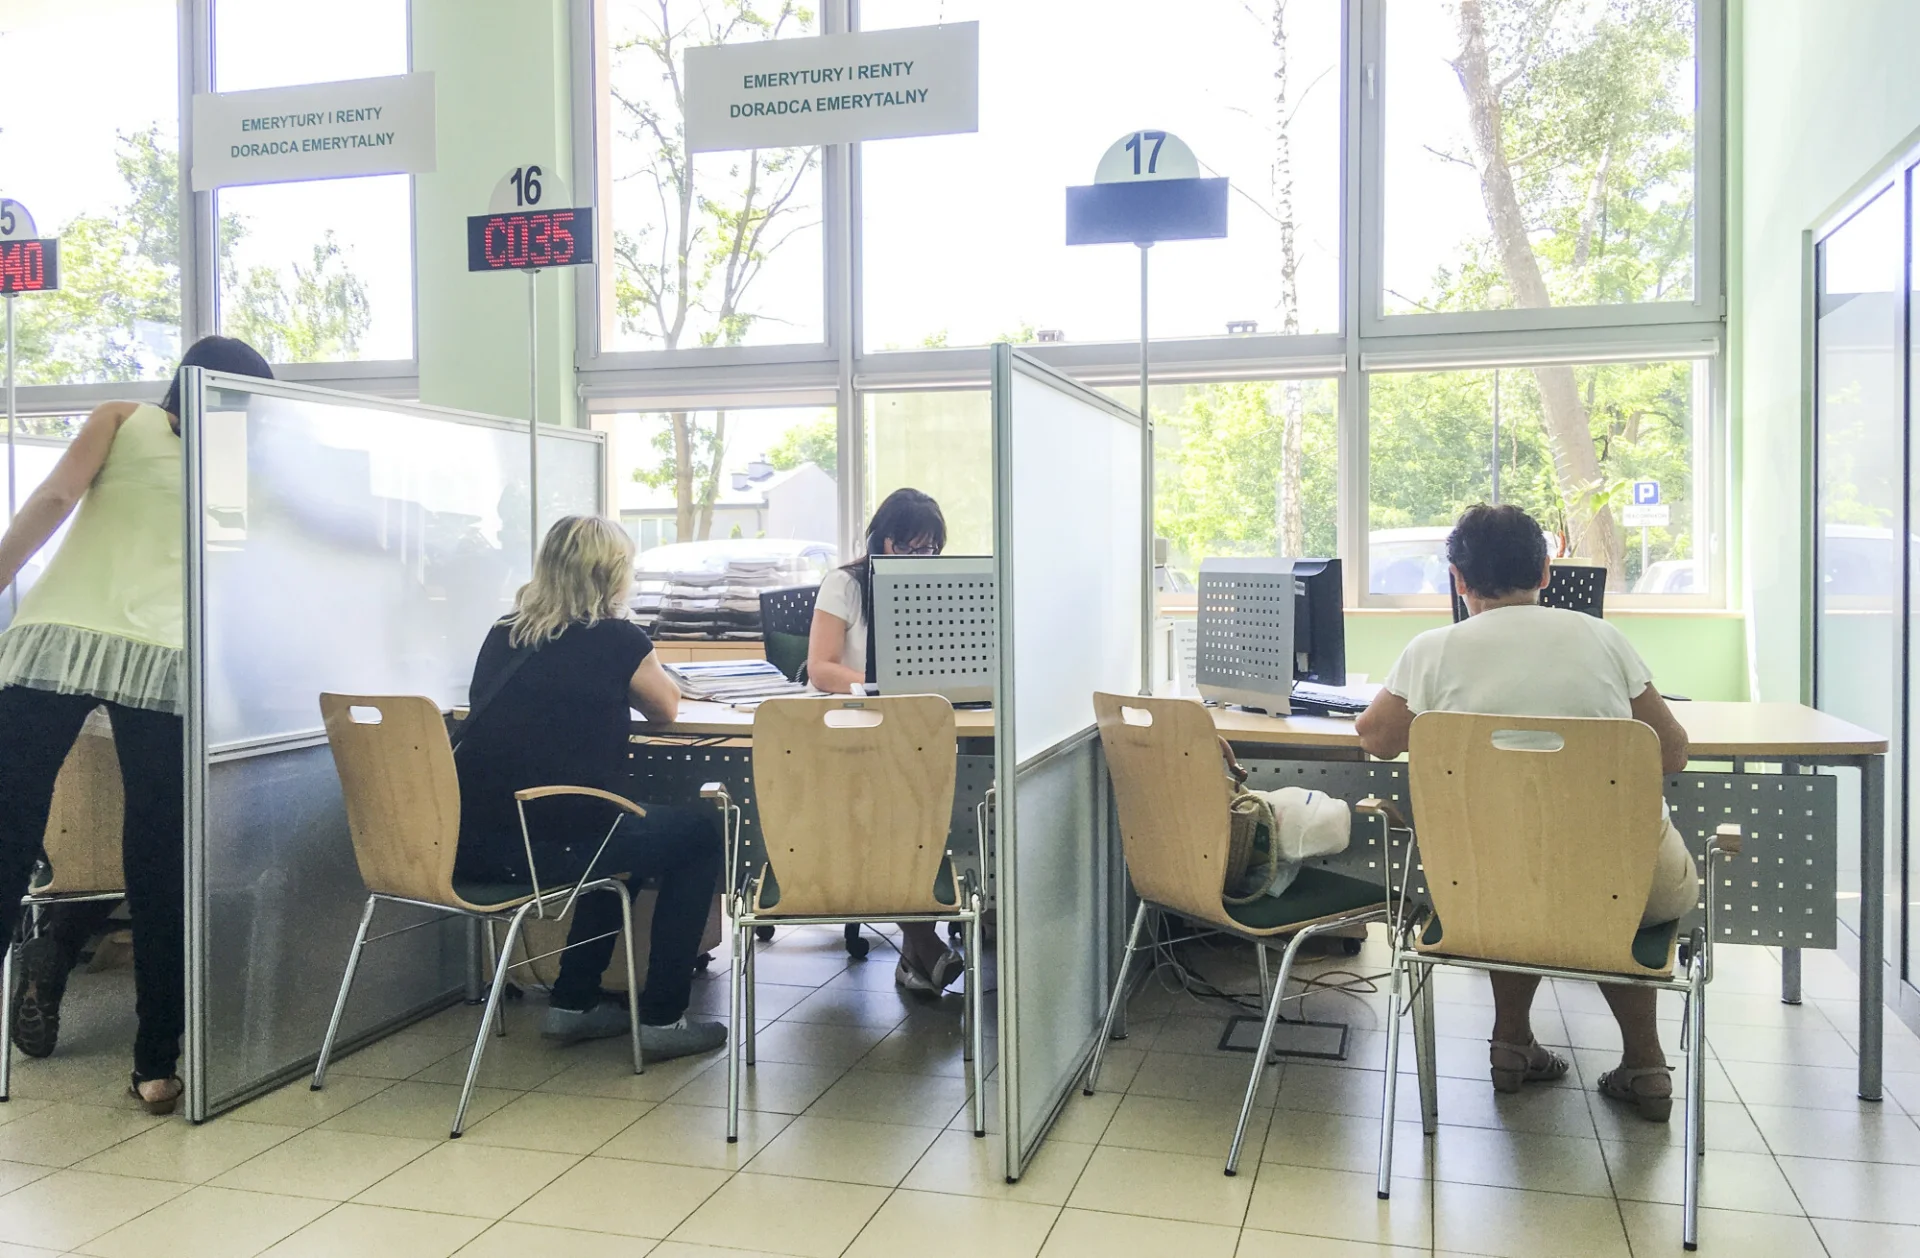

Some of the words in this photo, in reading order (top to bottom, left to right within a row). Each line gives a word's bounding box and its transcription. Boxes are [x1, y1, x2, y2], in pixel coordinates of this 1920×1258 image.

[743, 67, 844, 89] EMERYTURY
[848, 66, 853, 81] I
[857, 61, 915, 80] RENTY
[729, 99, 812, 118] DORADCA
[816, 88, 929, 111] EMERYTALNY
[241, 112, 325, 132] EMERYTURY
[328, 111, 333, 124] I
[335, 106, 383, 123] RENTY
[230, 140, 299, 158] DORADCA
[302, 132, 396, 153] EMERYTALNY
[1125, 131, 1167, 175] 17
[510, 165, 542, 206] 16
[0, 242, 44, 291] 40
[1639, 483, 1655, 503] P
